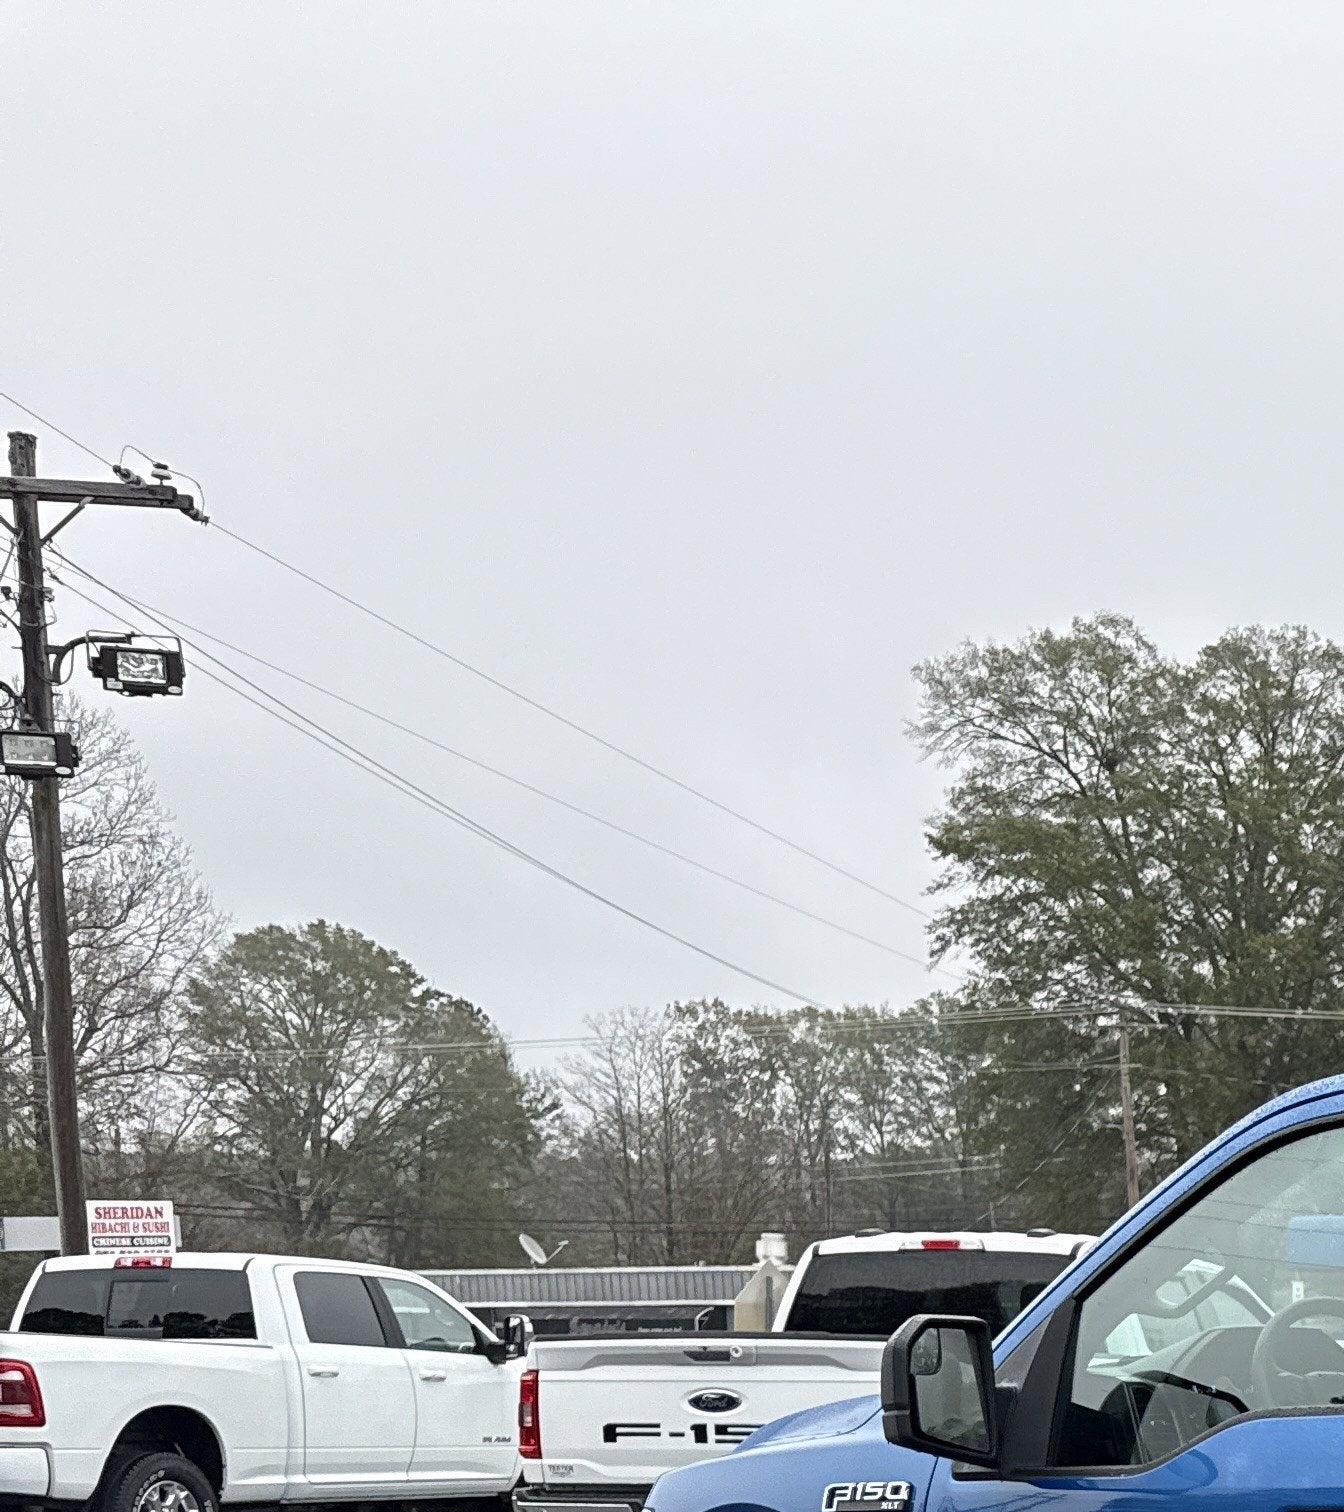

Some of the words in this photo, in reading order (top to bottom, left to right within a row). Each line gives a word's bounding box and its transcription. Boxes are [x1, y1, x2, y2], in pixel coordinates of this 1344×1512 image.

[94, 1206, 164, 1220] SHERIDAN
[91, 1222, 130, 1234] HIBACHI
[141, 1222, 170, 1234] SUSHI
[602, 1422, 766, 1444] F-15
[880, 1501, 901, 1510] XLT
